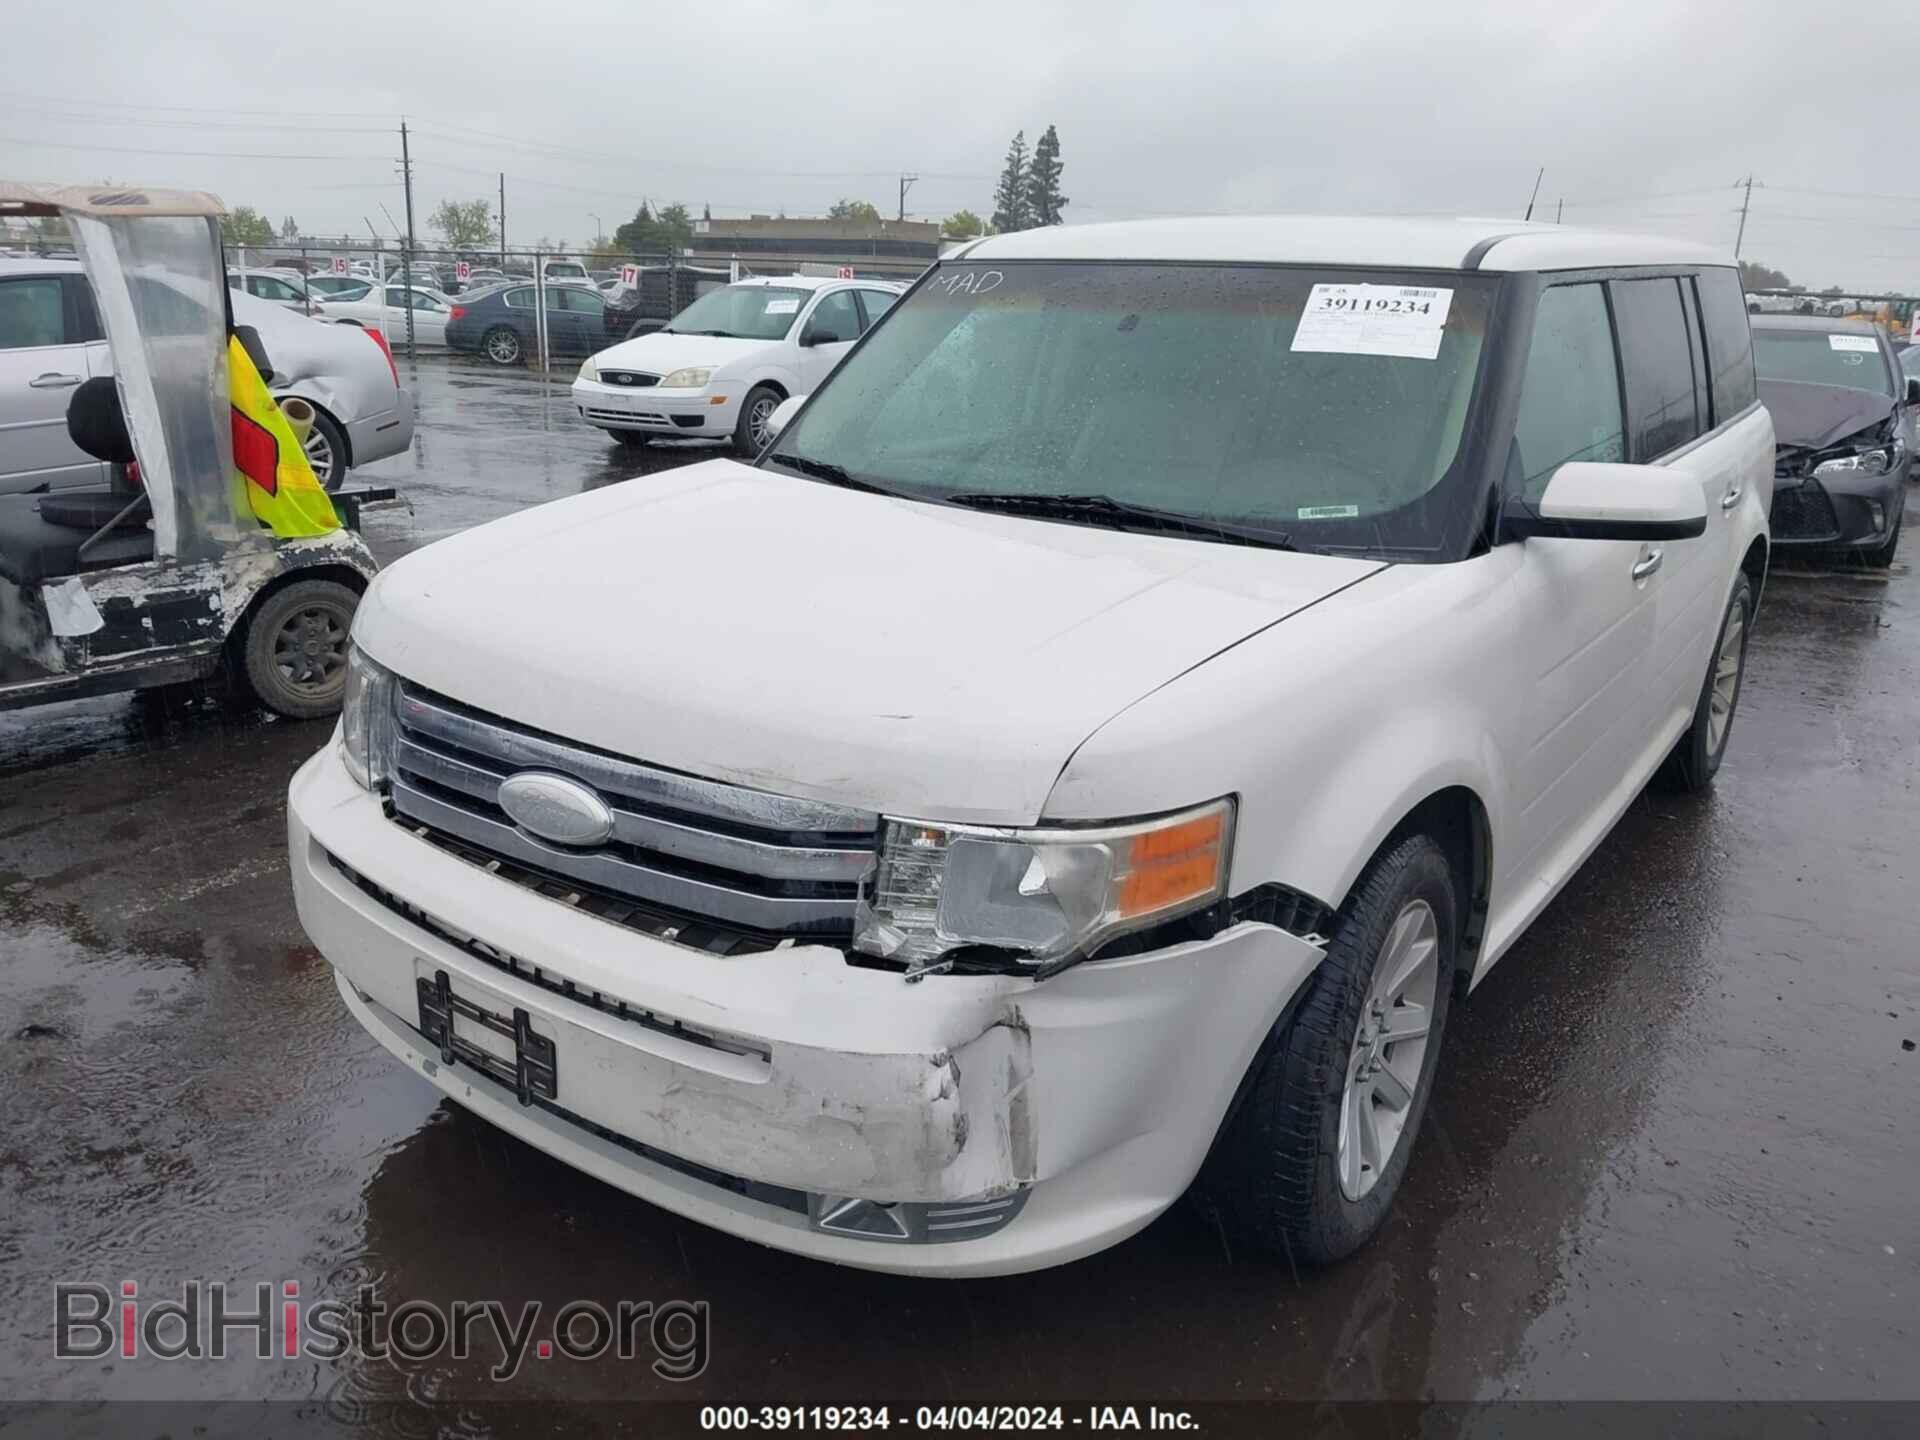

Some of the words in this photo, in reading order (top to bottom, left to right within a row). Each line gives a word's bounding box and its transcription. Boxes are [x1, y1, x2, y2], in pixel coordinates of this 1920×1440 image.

[335, 258, 346, 272] 15
[456, 263, 469, 278] 16
[623, 267, 636, 283] 17
[927, 270, 1004, 295] MAD
[1318, 297, 1431, 315] 39119234
